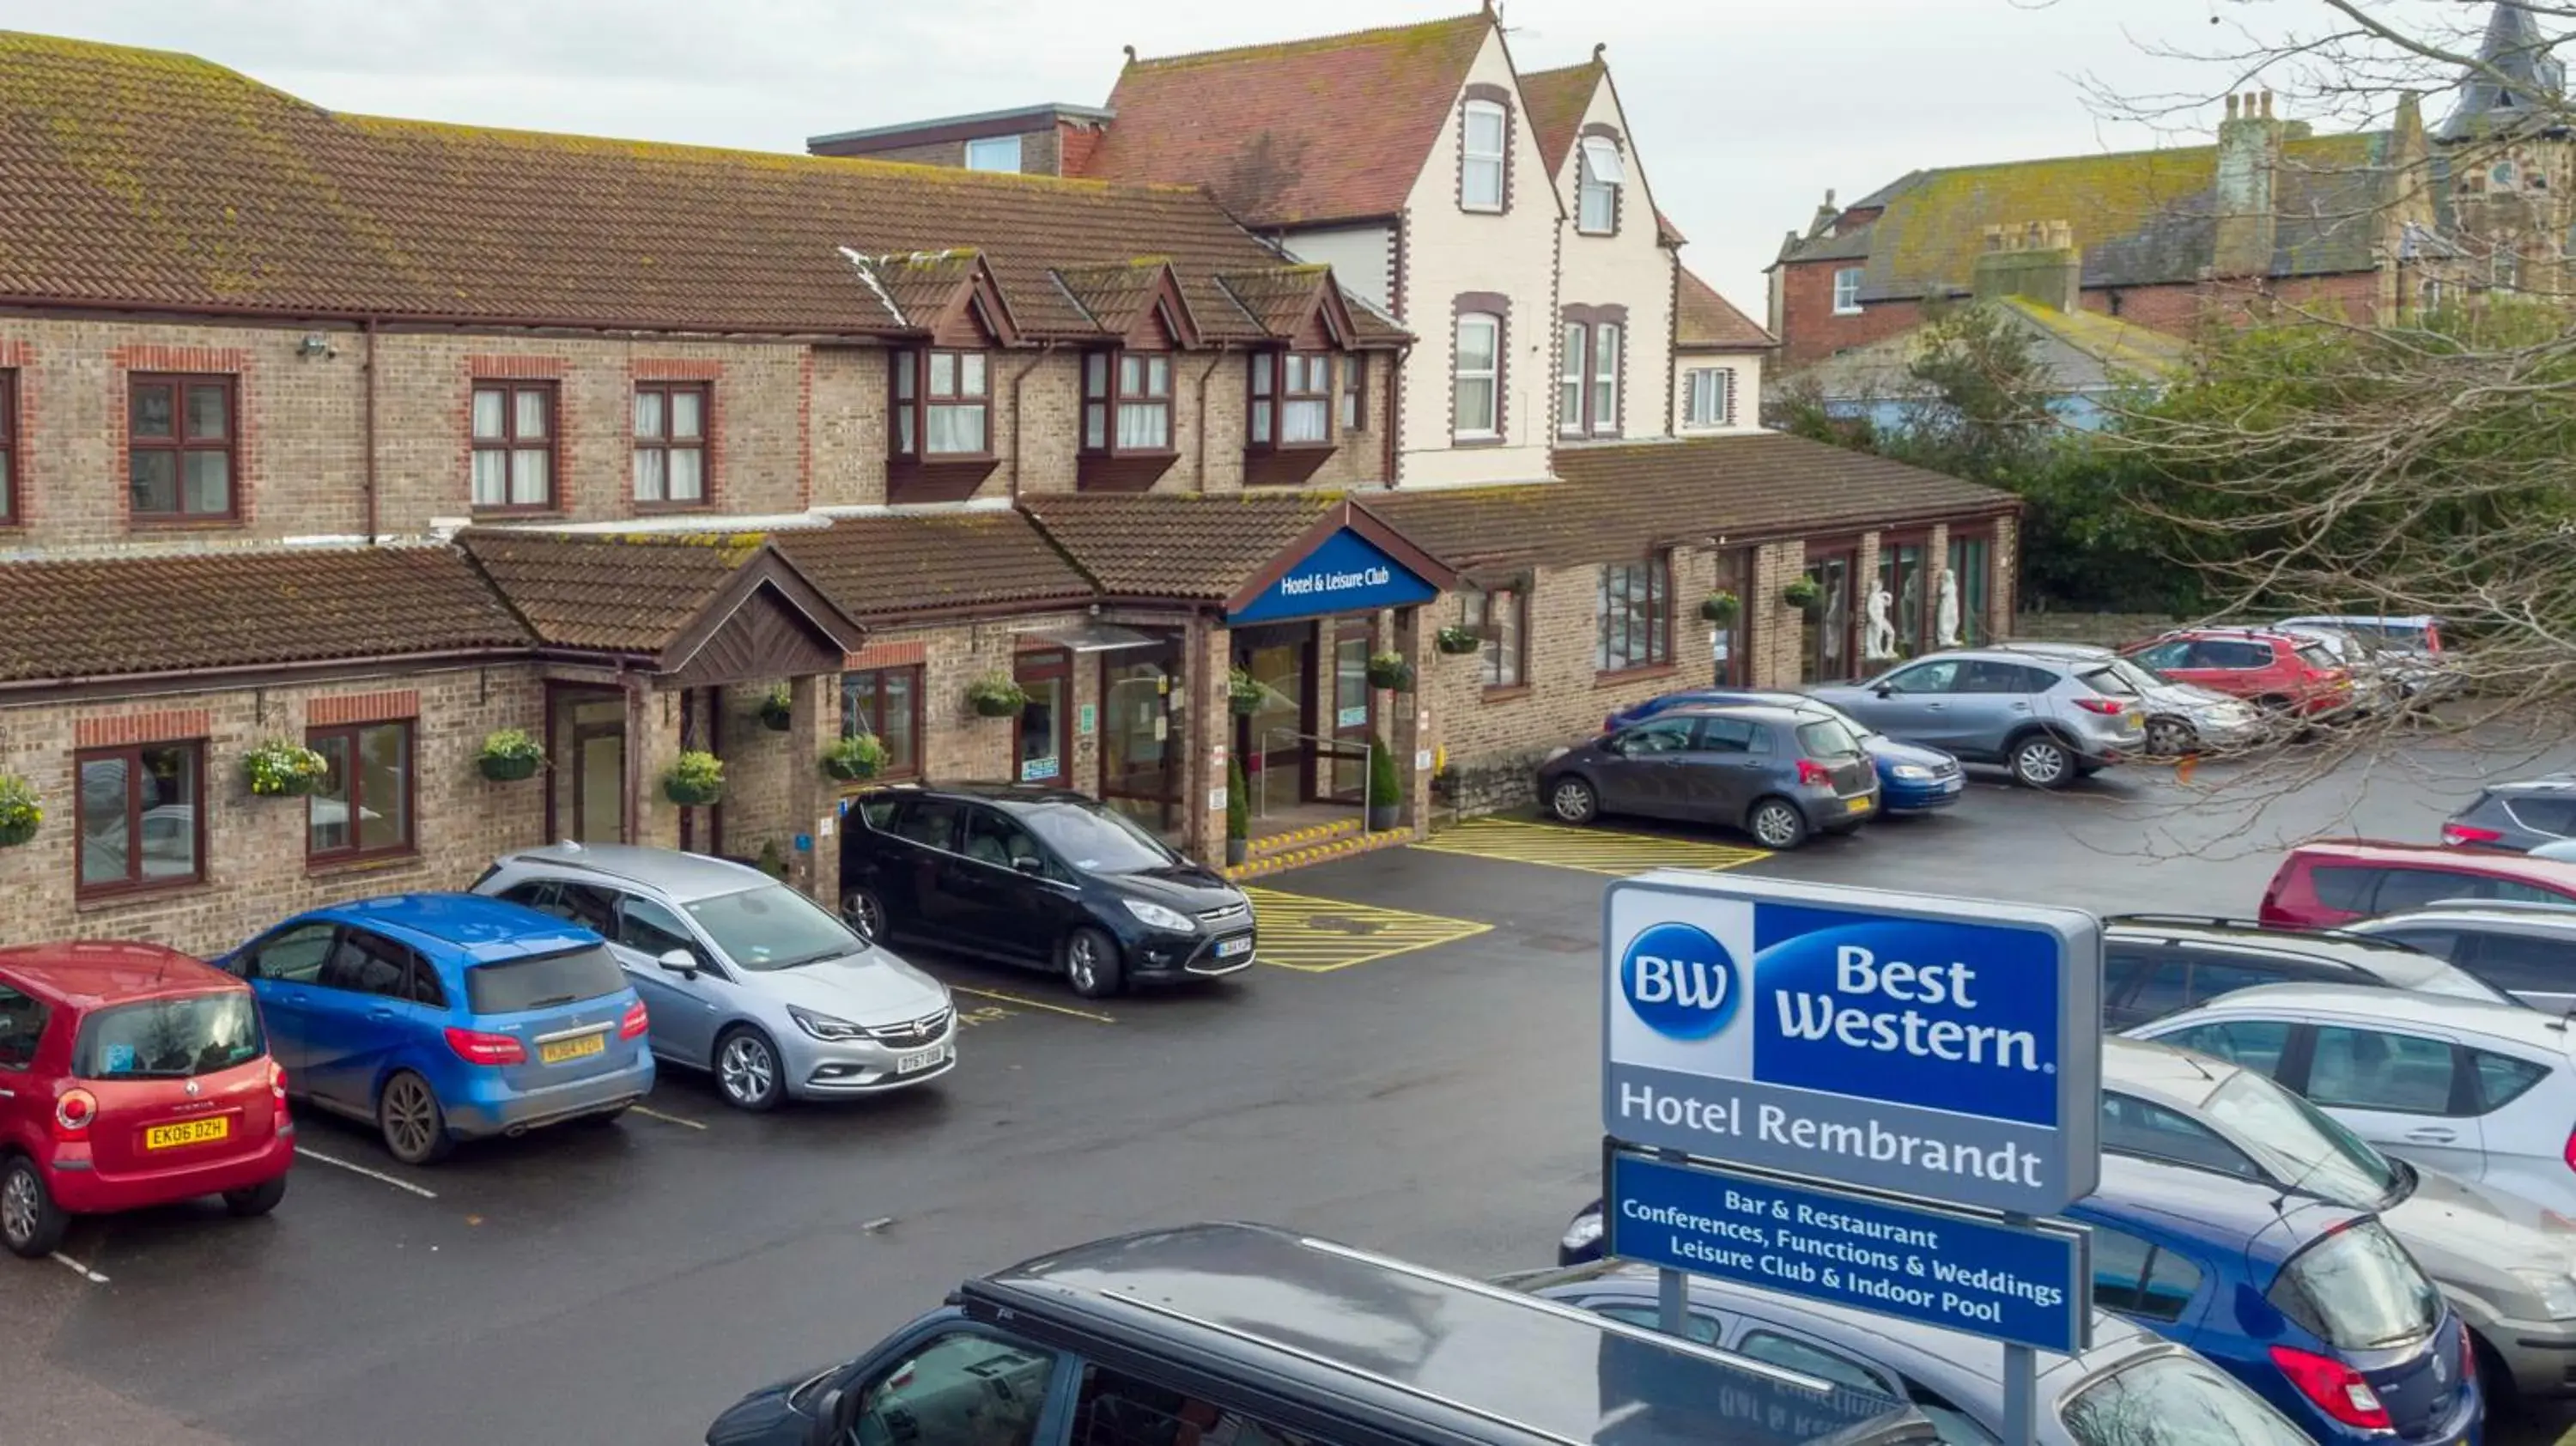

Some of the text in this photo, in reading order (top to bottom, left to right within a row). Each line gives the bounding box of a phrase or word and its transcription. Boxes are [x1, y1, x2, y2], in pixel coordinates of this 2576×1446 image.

[1281, 565, 1389, 596] Hotel & Leisure Club
[1635, 956, 1727, 1010] BW
[1838, 945, 1978, 1008] Best
[1776, 989, 2039, 1072] Western
[154, 1118, 222, 1145] EK06 DZH
[1621, 1082, 2043, 1187] Hotel Rembrandt
[1725, 1190, 1939, 1249] Bar & Restaurant
[1623, 1199, 2063, 1307] Conferences, Functions & Weddings
[1671, 1236, 2002, 1323] Leisure Club & Indoor Pool
